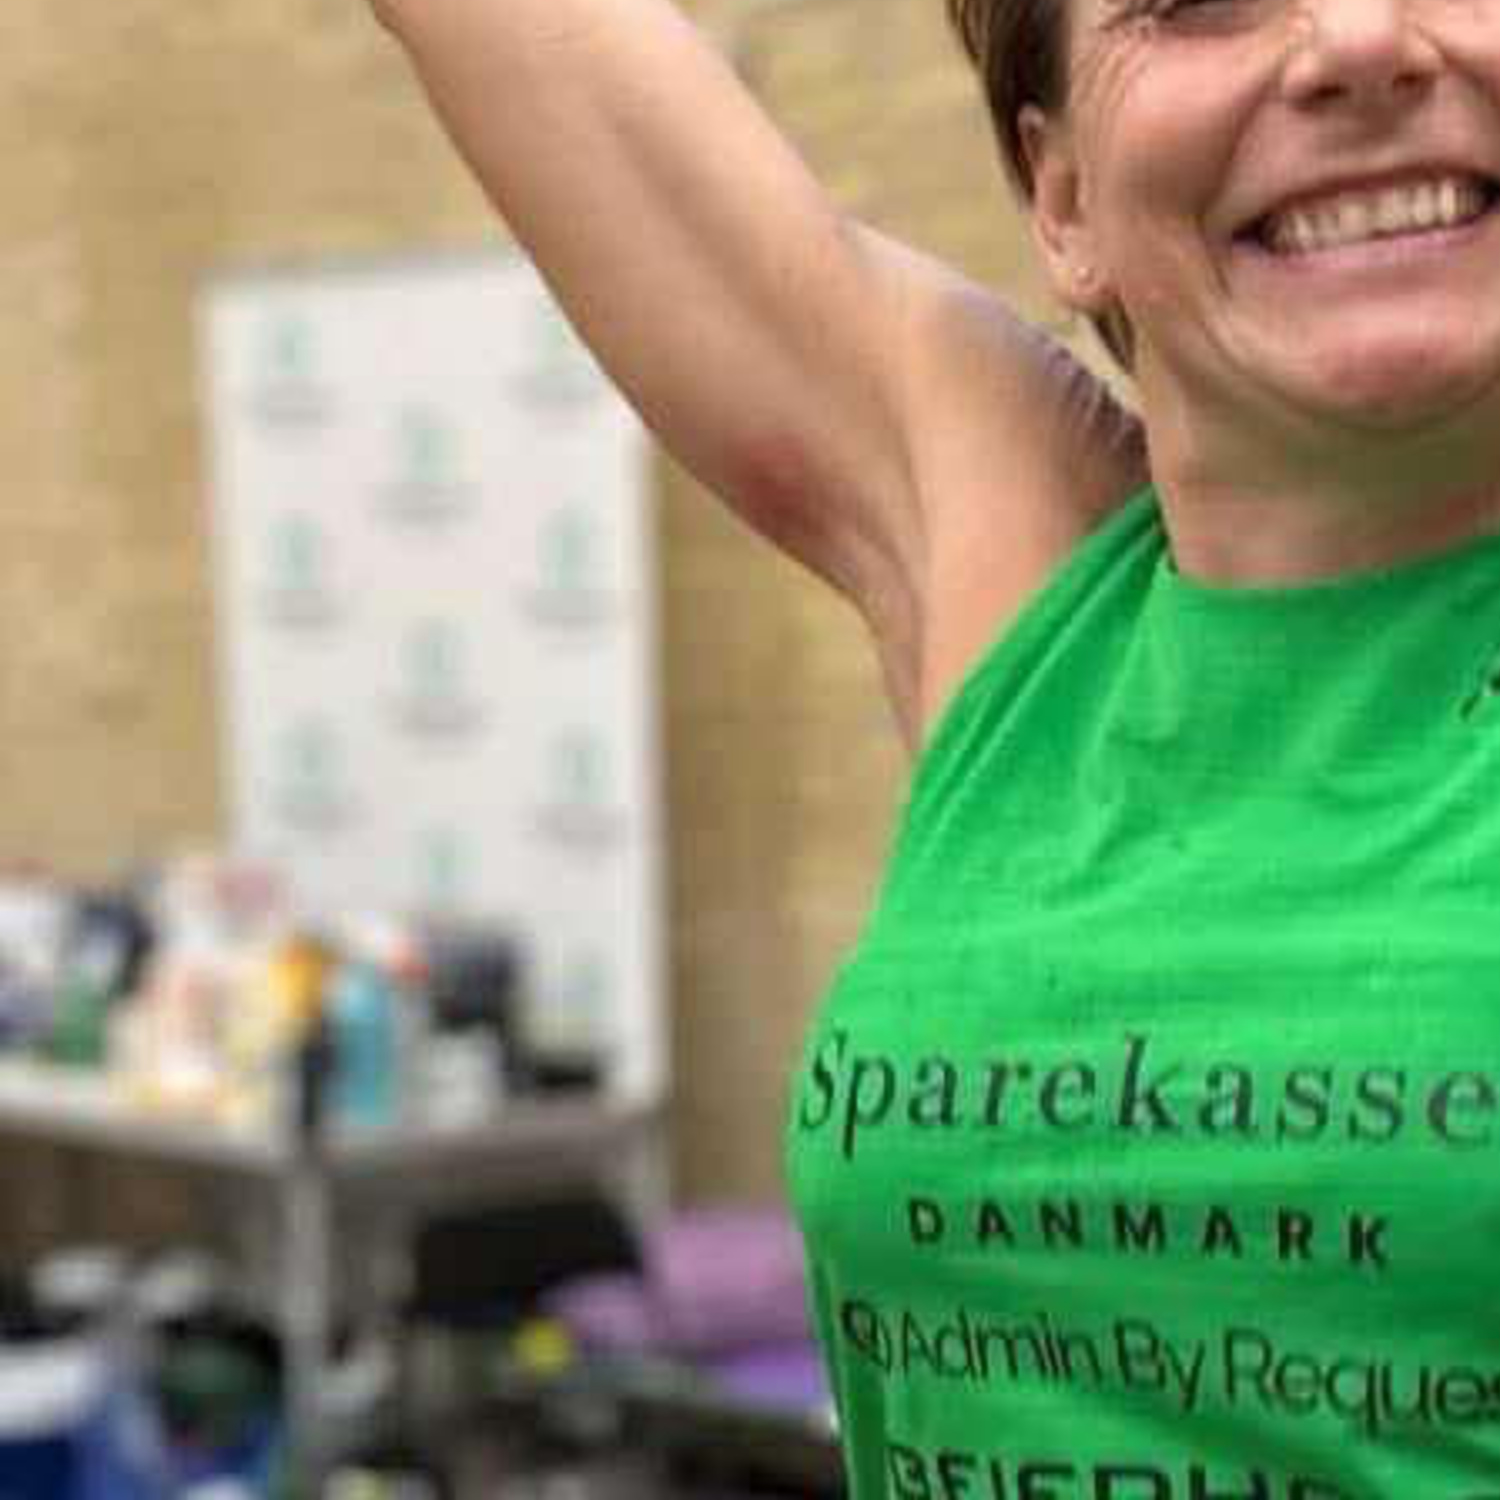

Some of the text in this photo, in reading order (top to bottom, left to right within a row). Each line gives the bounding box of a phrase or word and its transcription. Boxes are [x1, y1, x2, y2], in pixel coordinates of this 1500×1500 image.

[908, 1196, 1388, 1268] DANMARK
[900, 1306, 1104, 1386] Admin
[1110, 1318, 1206, 1414] By
